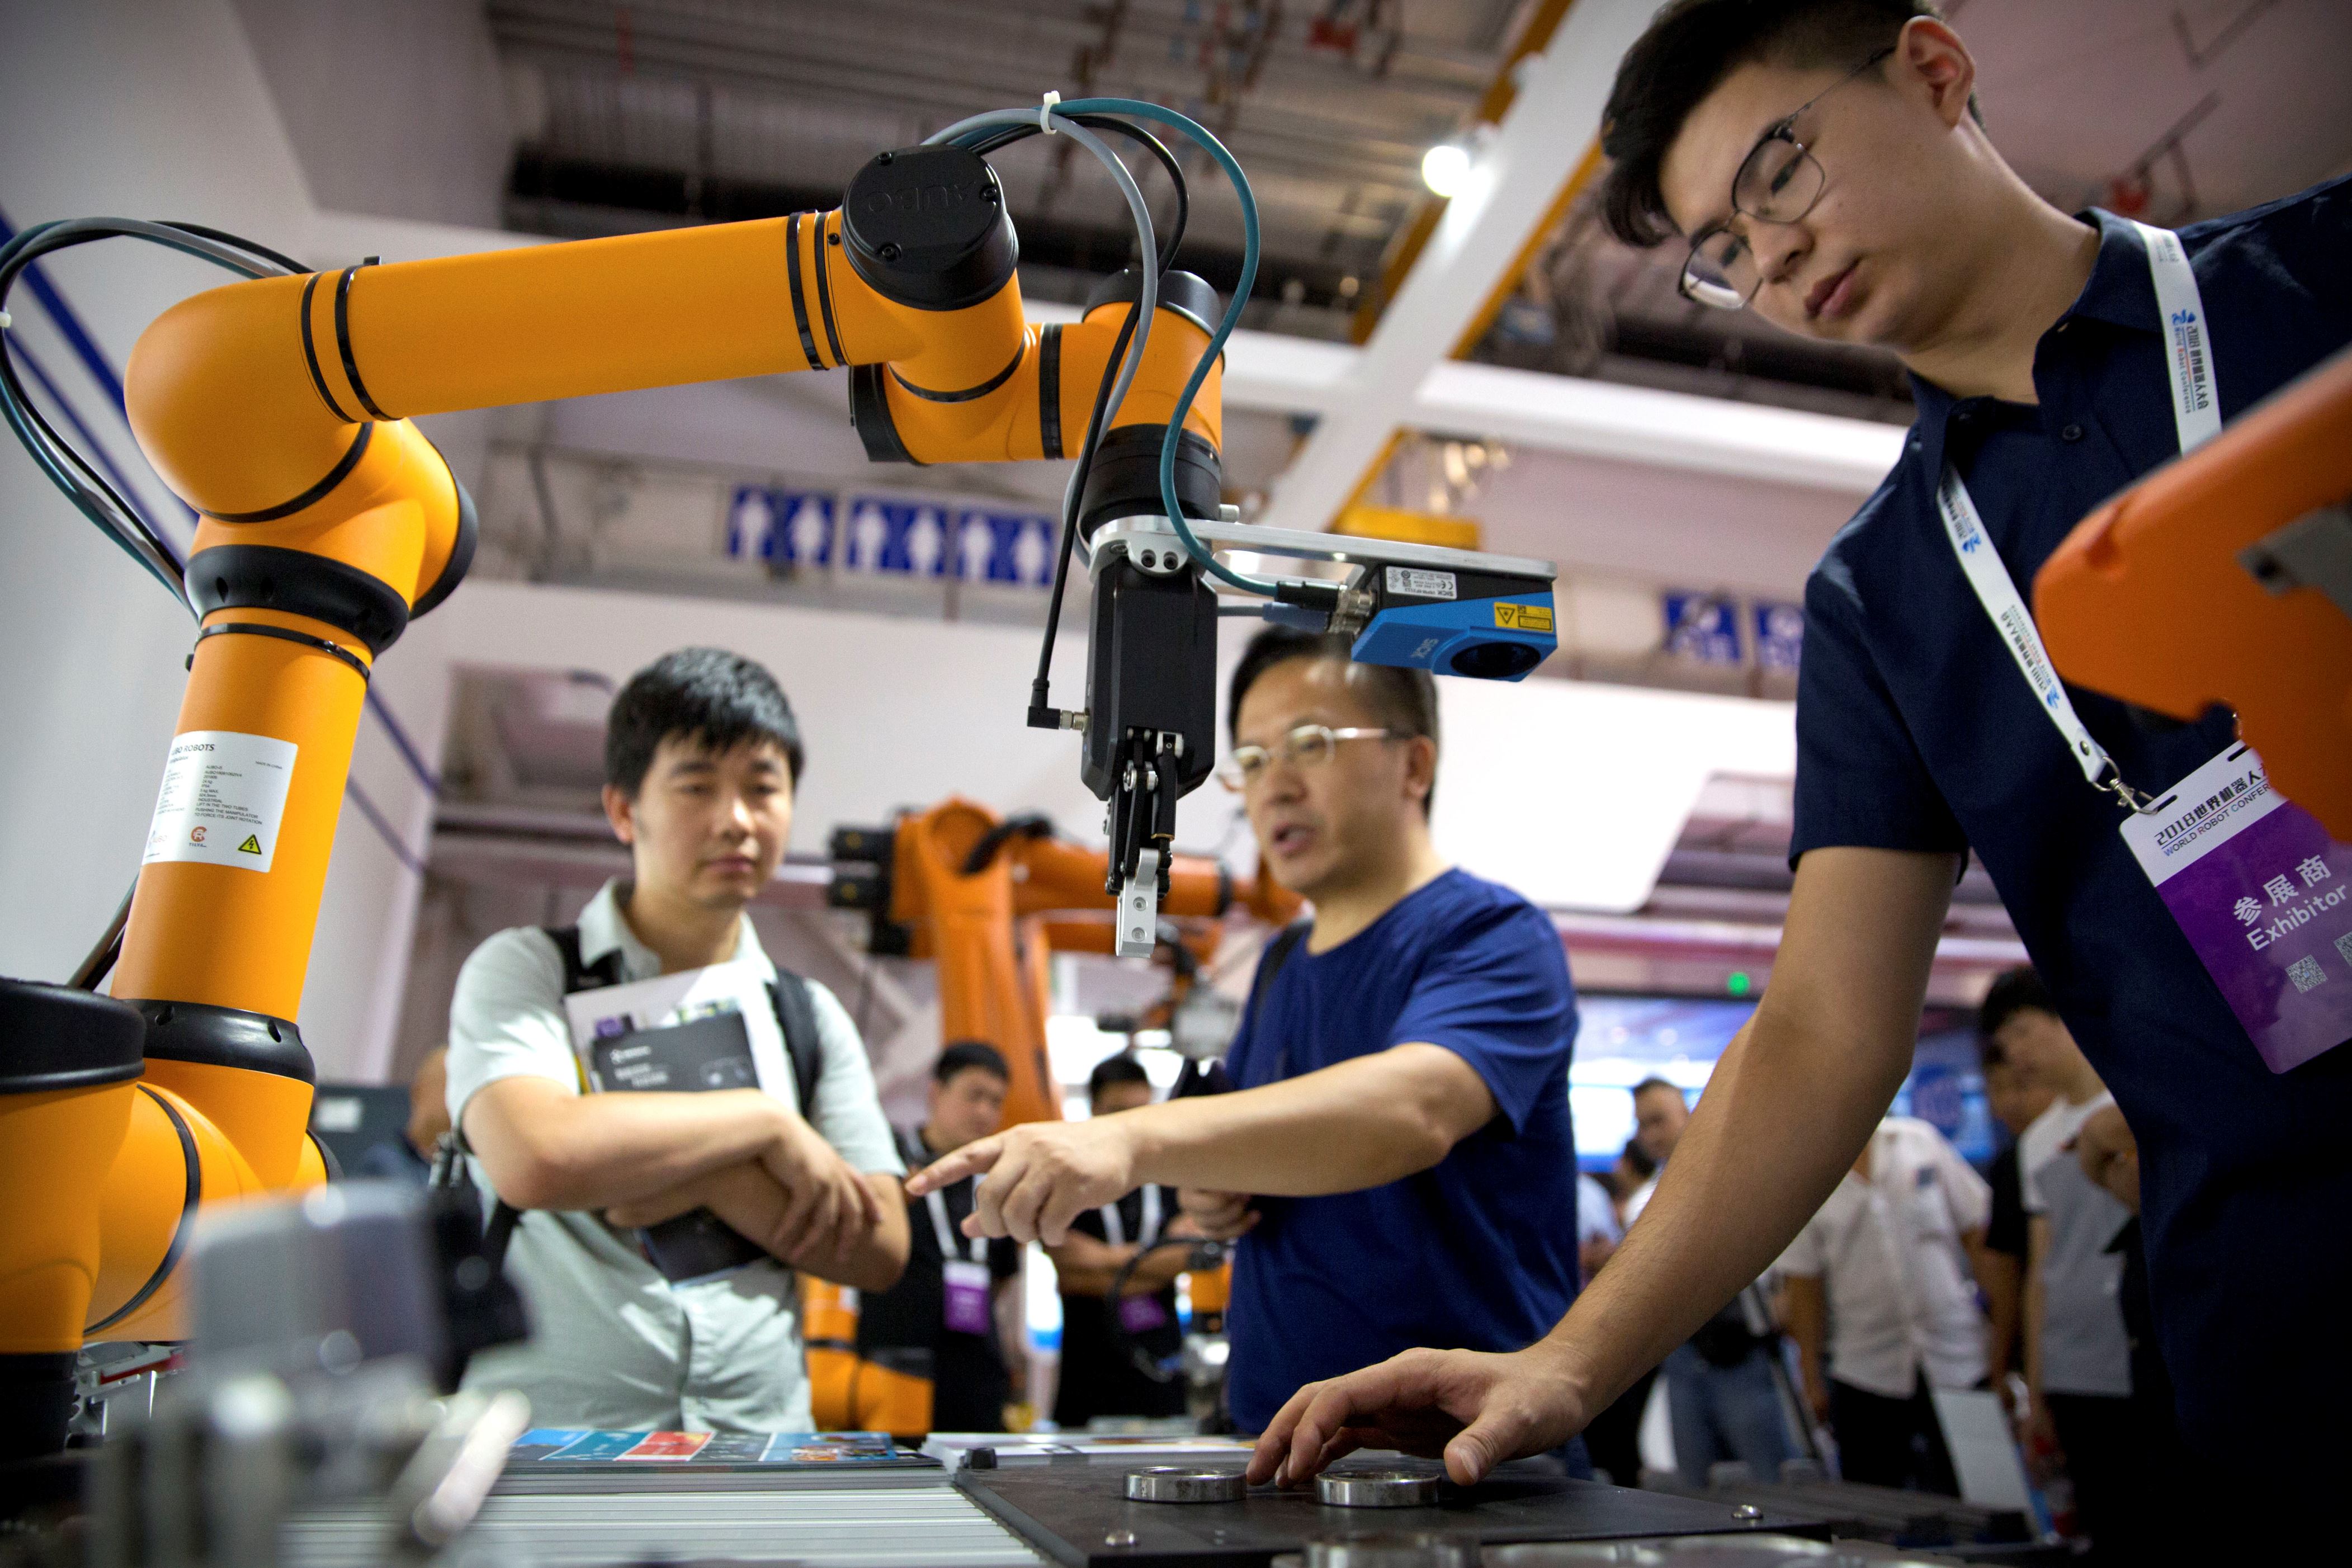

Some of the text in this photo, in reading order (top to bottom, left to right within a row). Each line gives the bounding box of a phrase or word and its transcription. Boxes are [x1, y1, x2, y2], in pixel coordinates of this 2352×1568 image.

[2164, 833, 2197, 856] WORLD
[2197, 810, 2230, 834] ROBOT
[2233, 854, 2332, 927] 参展商
[2246, 884, 2346, 951] Exhibitor
